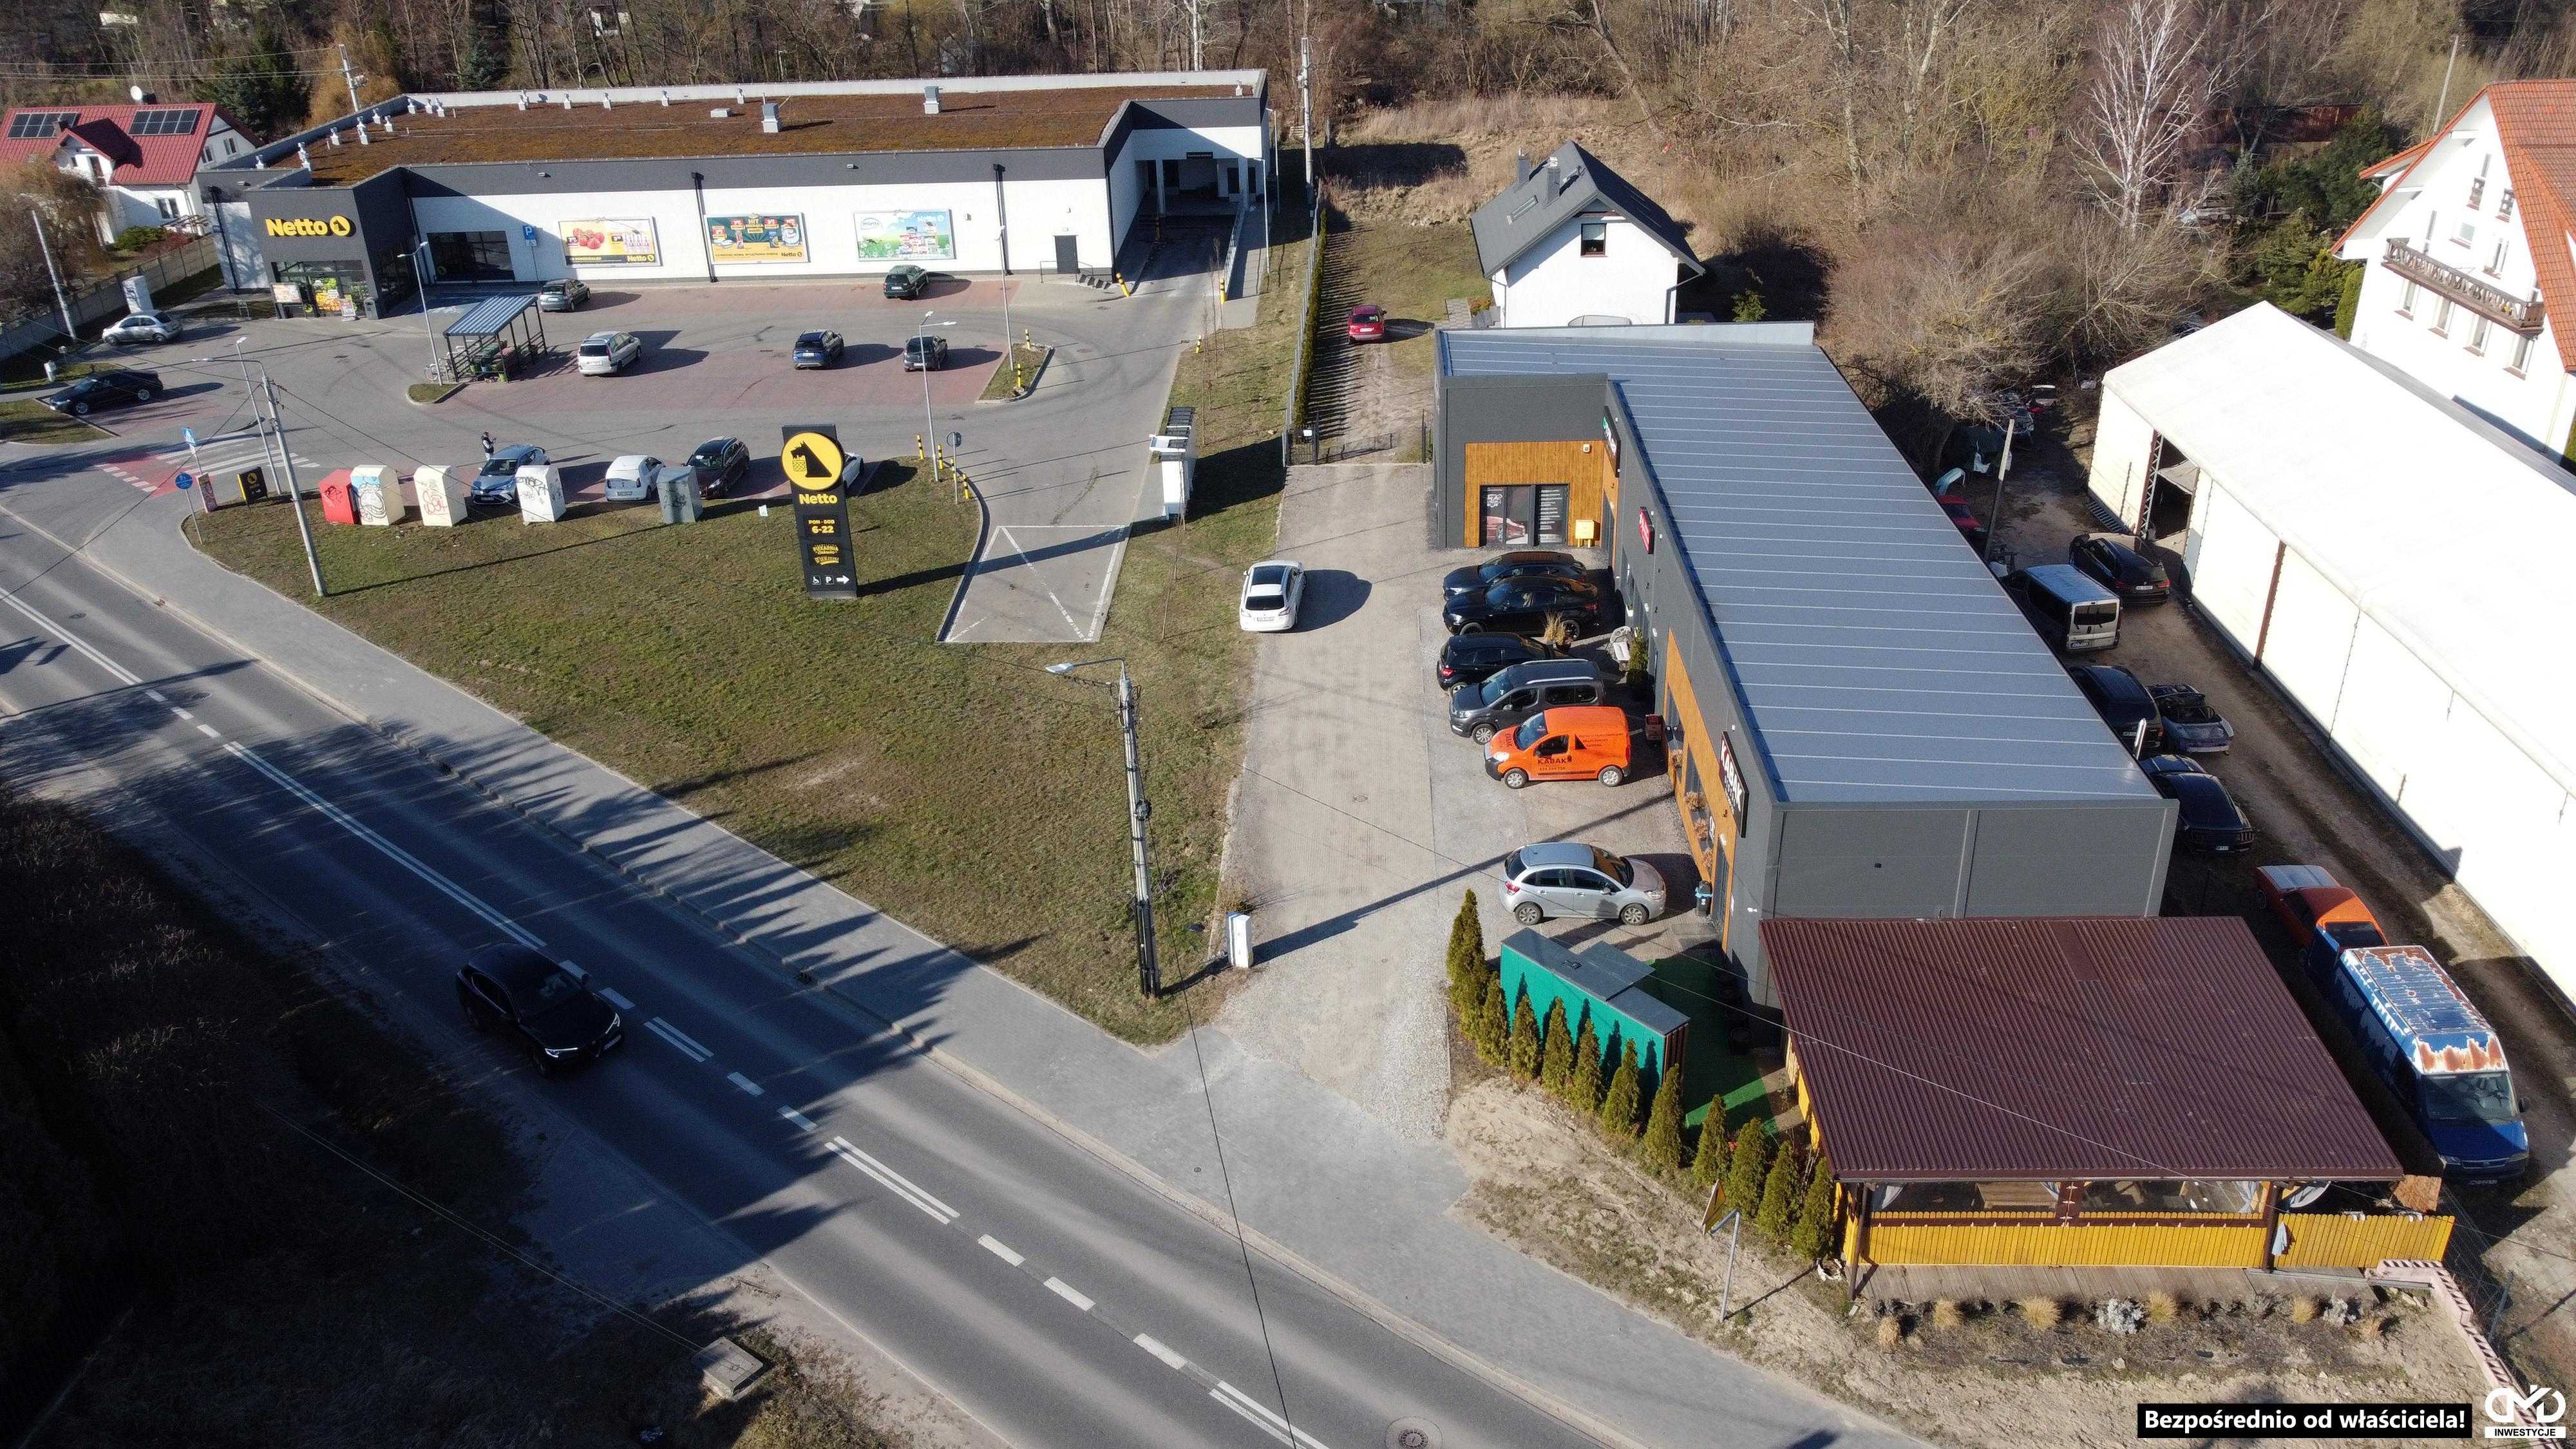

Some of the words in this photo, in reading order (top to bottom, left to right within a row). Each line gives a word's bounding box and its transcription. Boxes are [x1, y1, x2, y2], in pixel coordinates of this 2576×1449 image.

[265, 218, 327, 236] Netto
[799, 493, 838, 505] Netto
[811, 526, 835, 534] 6-22
[1721, 739, 1743, 812] KABAK
